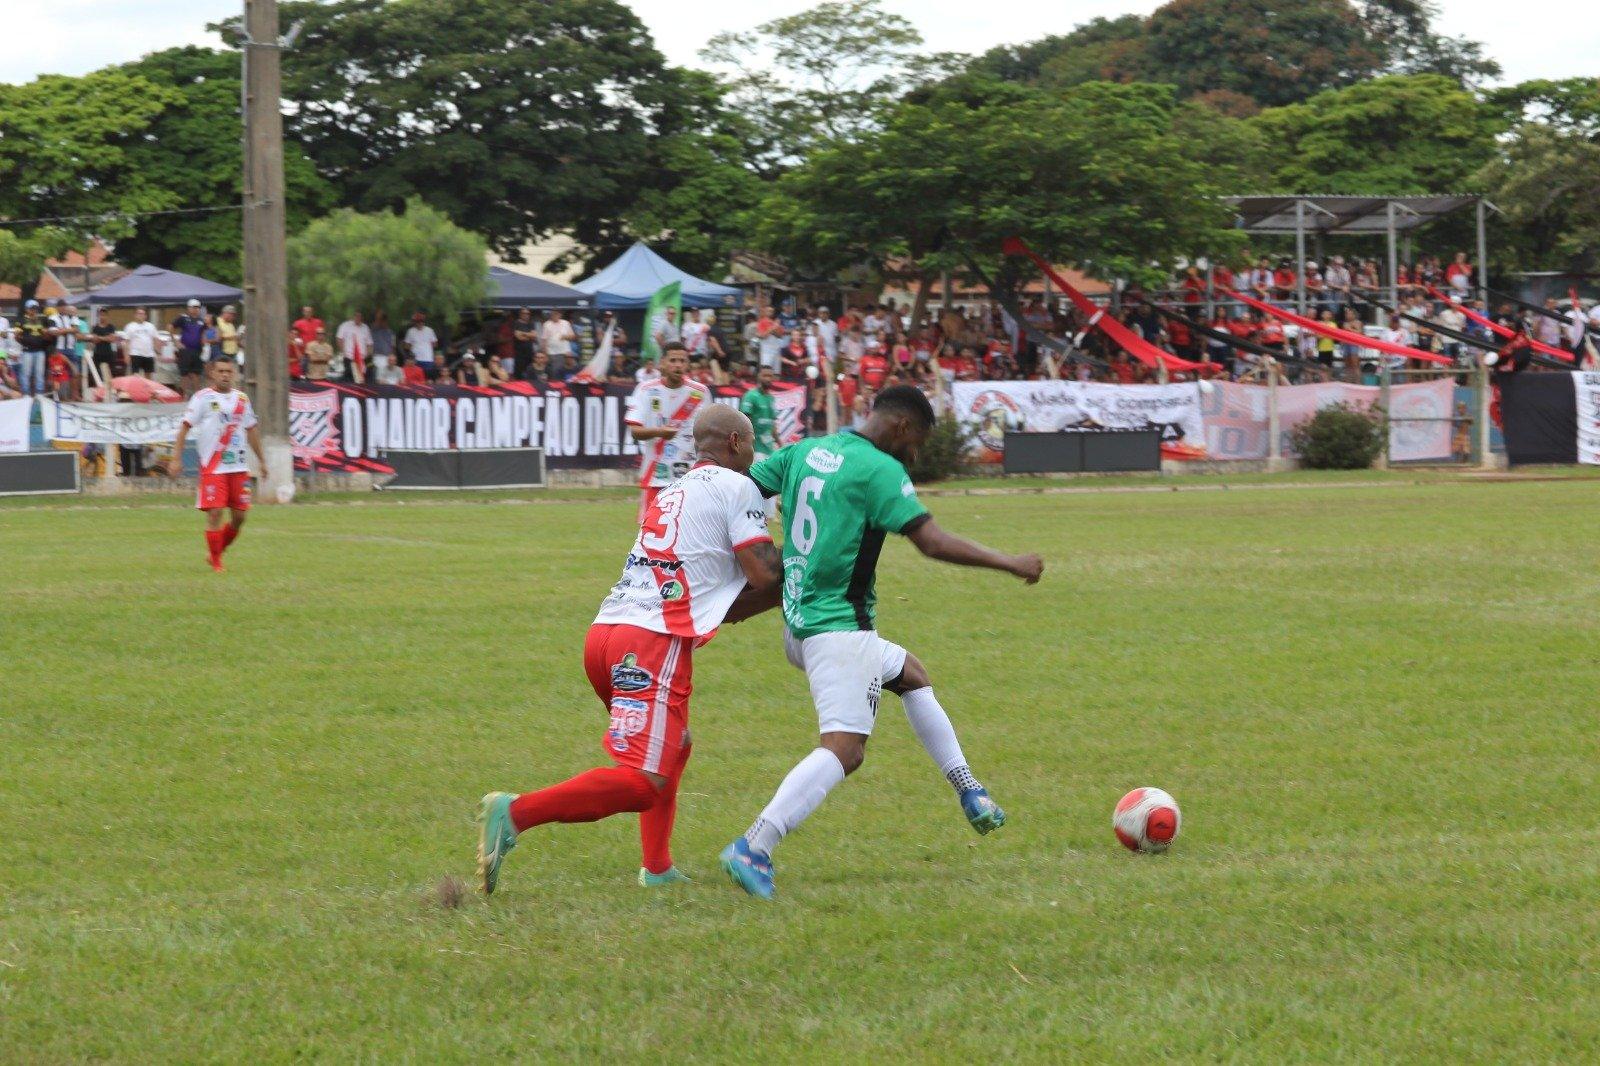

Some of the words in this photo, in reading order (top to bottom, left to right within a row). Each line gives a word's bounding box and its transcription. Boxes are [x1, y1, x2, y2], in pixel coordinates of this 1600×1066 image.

[342, 397, 363, 458] O
[366, 397, 450, 458] MAIOR
[456, 390, 580, 456] CAMPEÃO
[584, 396, 620, 456] DA
[641, 489, 685, 552] 3
[791, 476, 826, 556] 6
